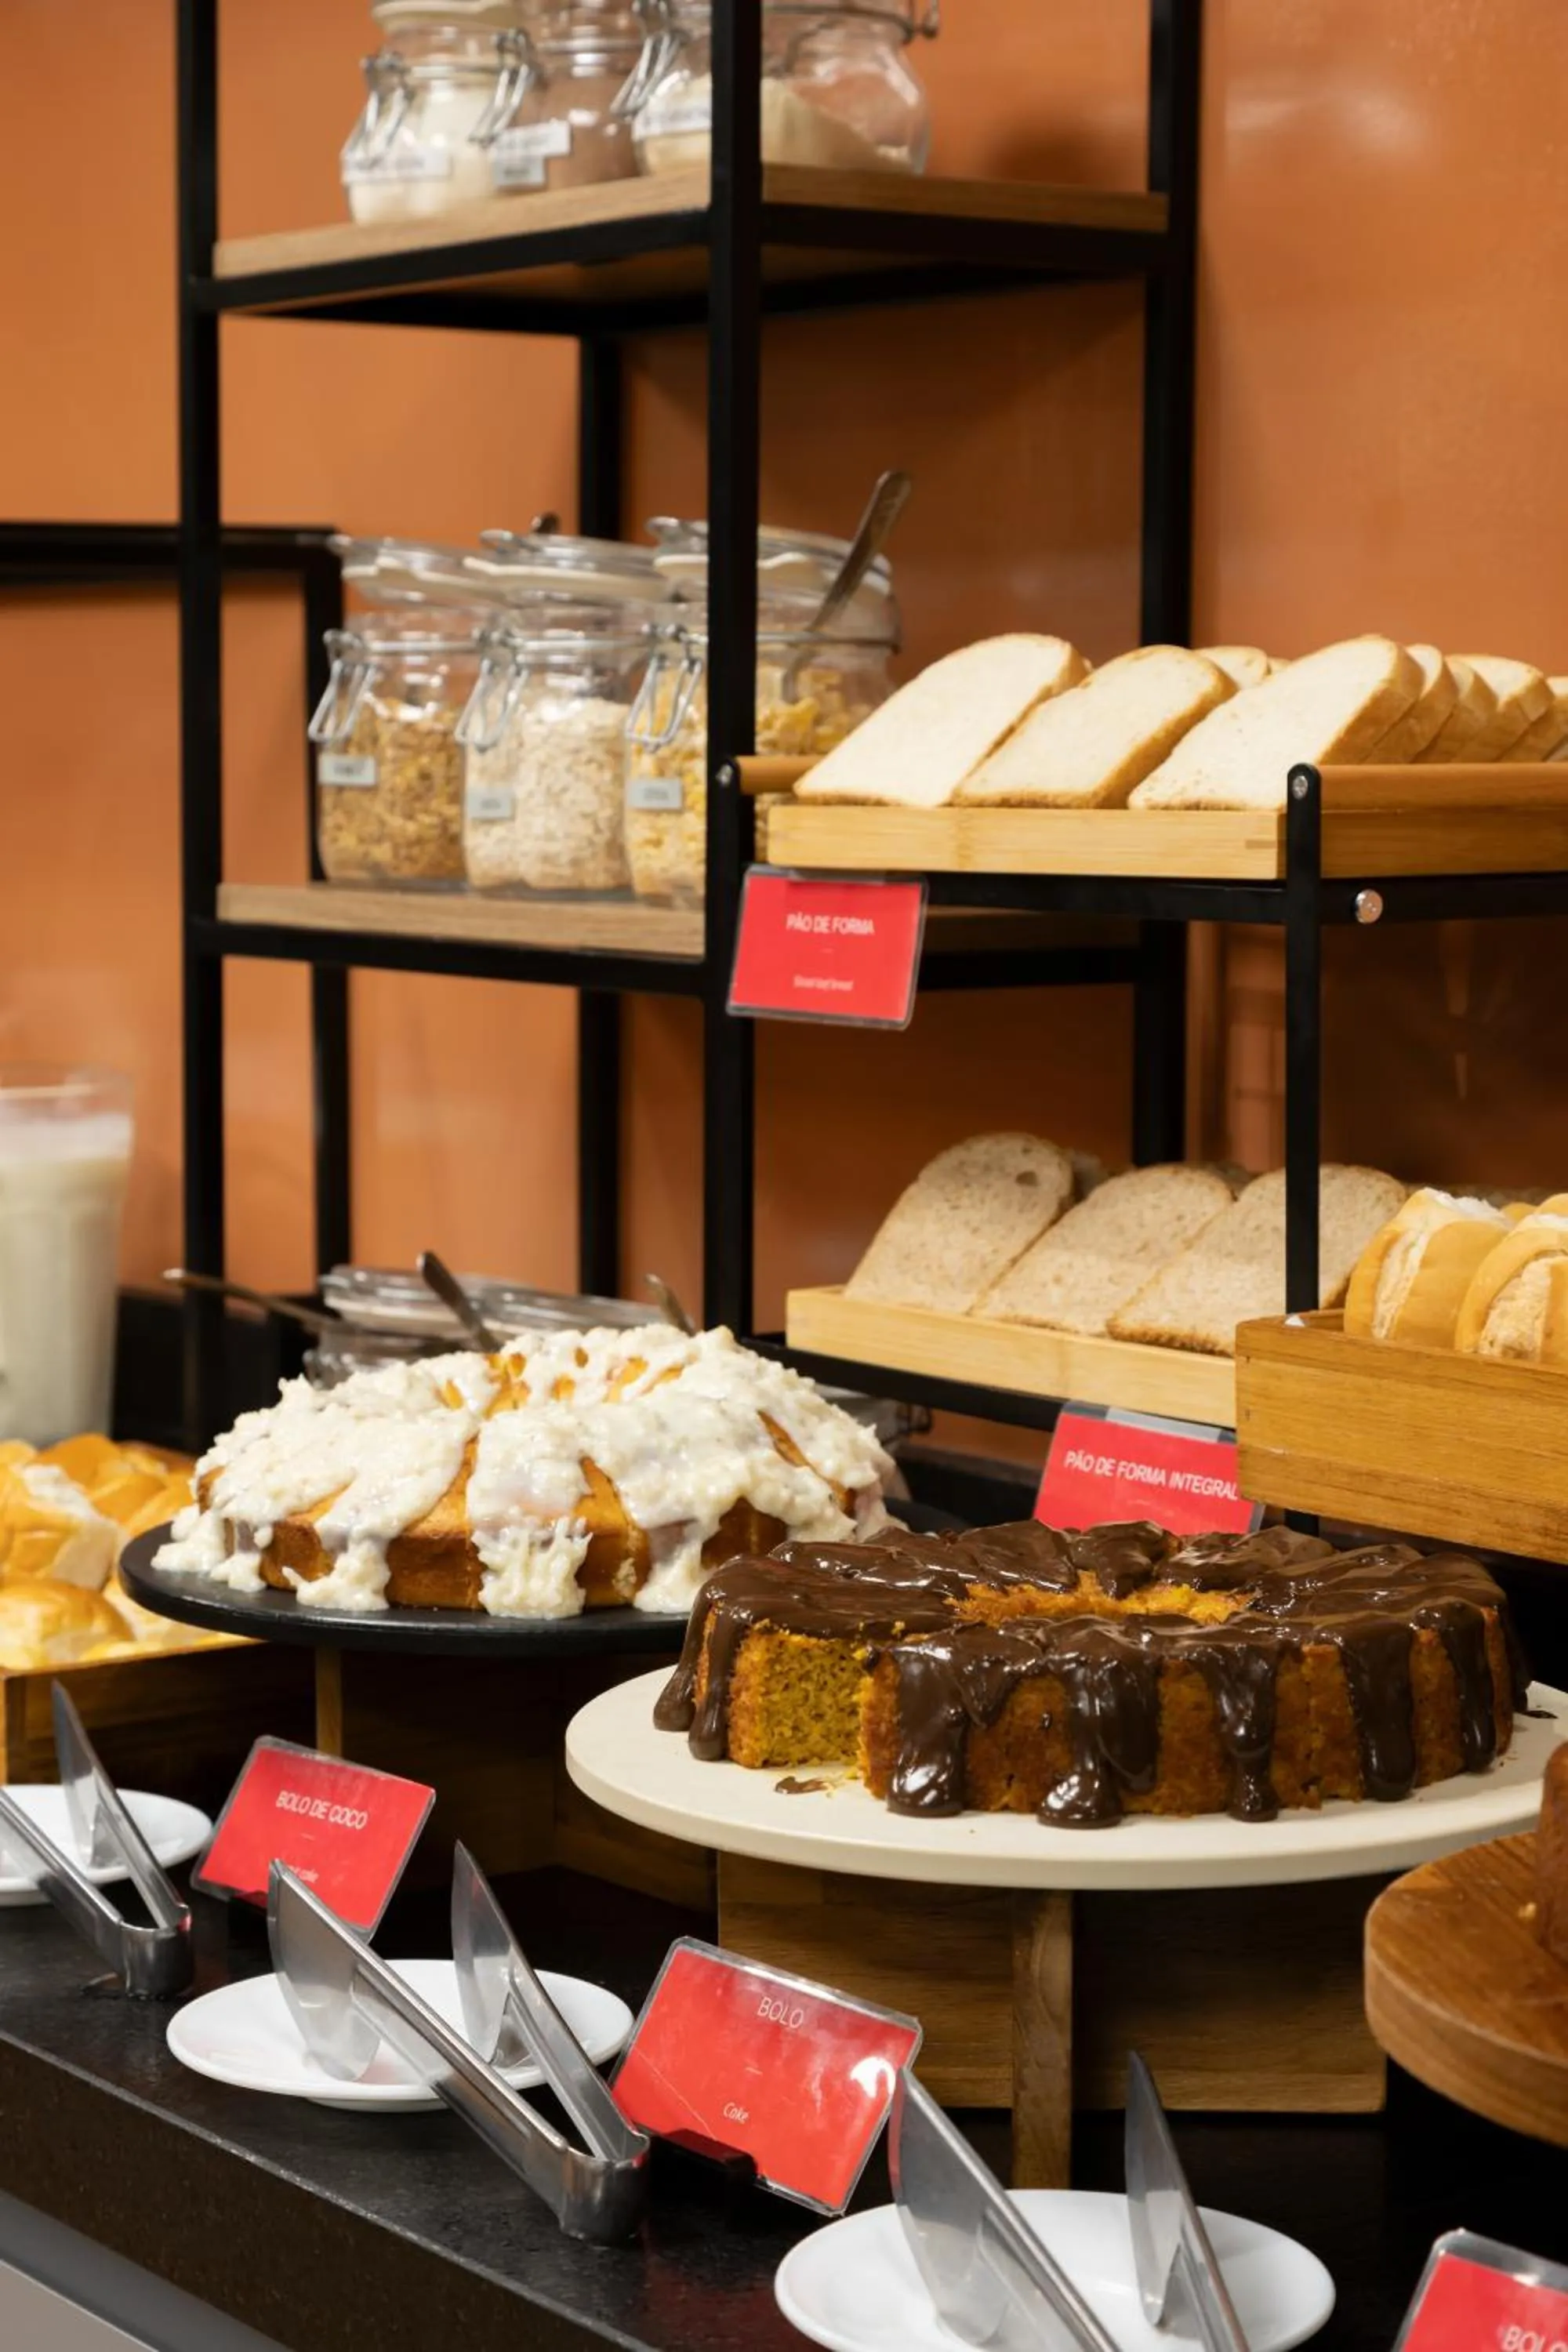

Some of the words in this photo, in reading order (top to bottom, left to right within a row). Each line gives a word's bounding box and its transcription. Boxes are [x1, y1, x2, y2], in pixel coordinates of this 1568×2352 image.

[786, 912, 812, 931] PÃO
[814, 915, 830, 933] DE
[833, 916, 875, 935] FORMA
[1065, 1450, 1094, 1471] PÃO
[1094, 1457, 1116, 1476] DE
[1117, 1461, 1166, 1486] FORMA
[1169, 1472, 1239, 1501] INTEGRAL
[276, 1791, 310, 1814] BOLO
[311, 1799, 328, 1820] DE
[328, 1805, 368, 1830] COCO
[757, 1996, 804, 2029] BOLO
[723, 2102, 750, 2125] Cake
